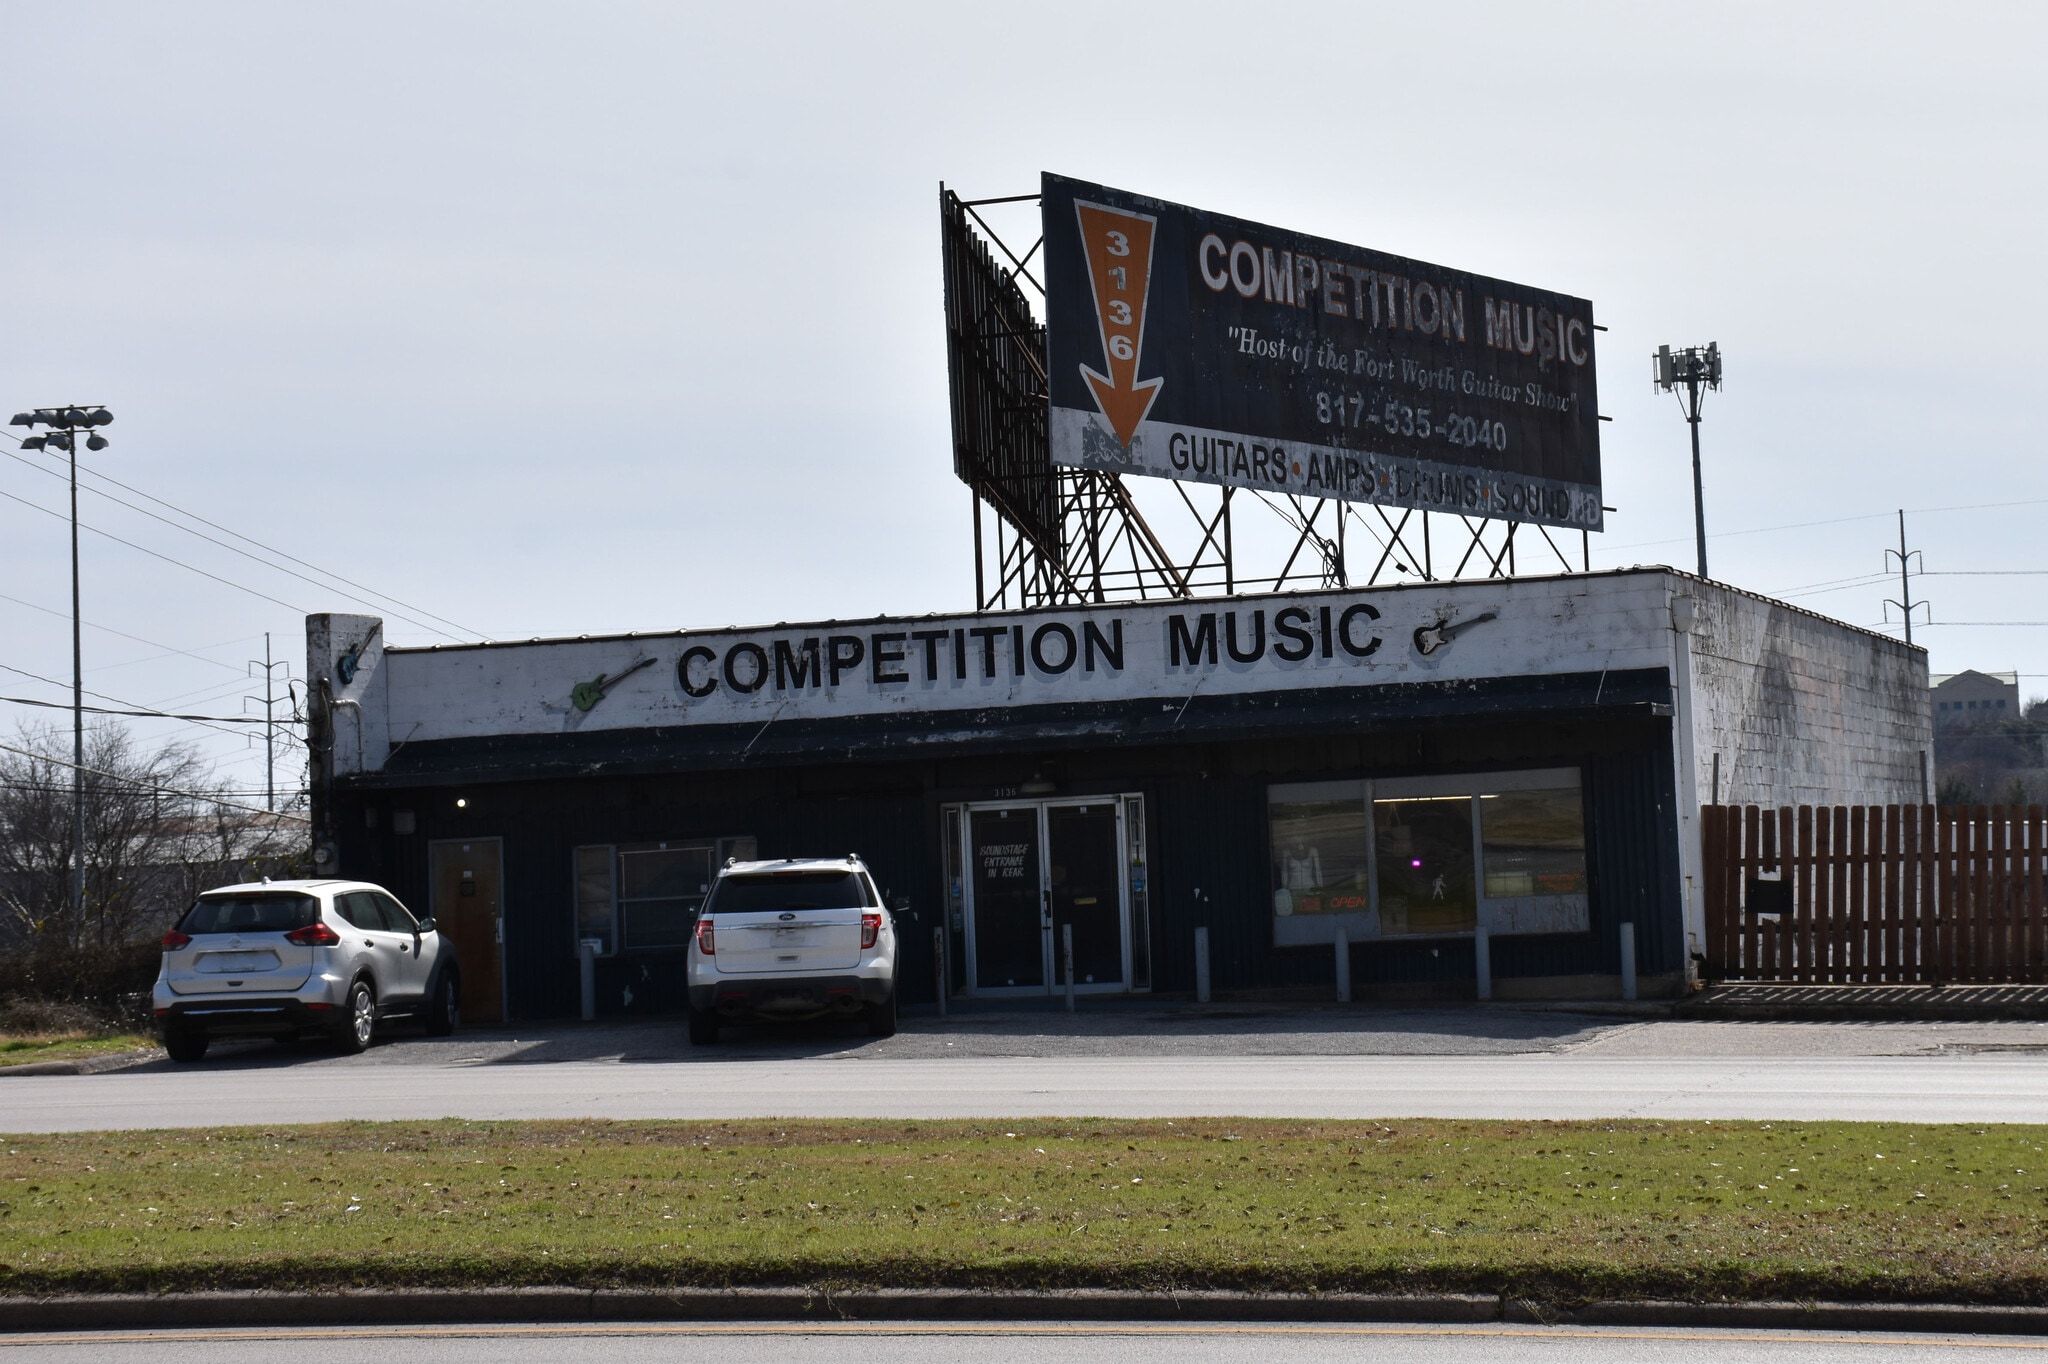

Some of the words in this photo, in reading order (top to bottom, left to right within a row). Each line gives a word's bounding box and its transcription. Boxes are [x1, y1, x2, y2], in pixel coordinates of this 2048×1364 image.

[1105, 230, 1135, 361] 3136
[1199, 232, 1467, 343] COMPETITION
[1485, 296, 1588, 366] MUSIC
[1292, 343, 1314, 370] of
[1317, 342, 1349, 371] the
[1353, 349, 1395, 381] Fort
[1401, 358, 1457, 391] Worth
[1460, 370, 1521, 404] Guitar
[1316, 391, 1508, 452] 817-535-2040
[1169, 432, 1288, 485] GUITARS
[1306, 452, 1376, 494] AMPS
[678, 618, 1125, 698] COMPETITION
[1168, 603, 1383, 667] MUSIC
[1330, 896, 1366, 908] OPEN
